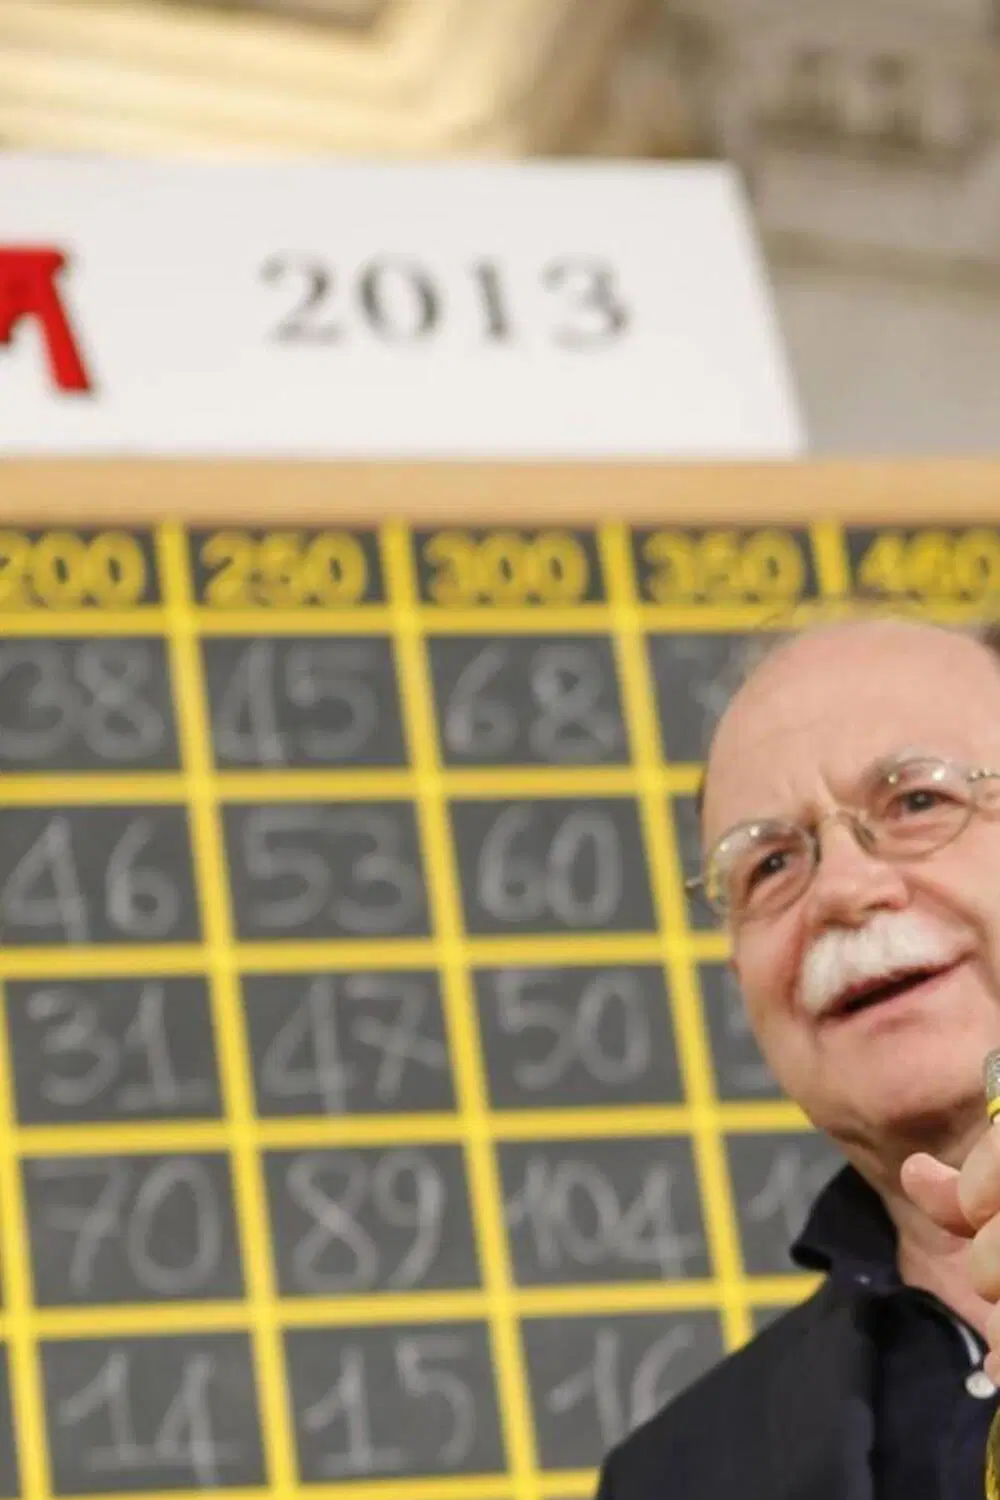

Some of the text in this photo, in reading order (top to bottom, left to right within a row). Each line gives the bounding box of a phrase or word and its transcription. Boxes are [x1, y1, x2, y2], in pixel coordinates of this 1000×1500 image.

[258, 250, 632, 350] 2013
[0, 529, 144, 608] 200
[203, 529, 368, 608] 250
[423, 529, 589, 606] 300
[643, 529, 804, 605] 350
[0, 640, 165, 761] 38
[214, 638, 380, 768] 45
[445, 642, 622, 764] 68
[2, 803, 623, 946] 46 53 60
[27, 984, 216, 1112] 31
[261, 970, 448, 1118] 47
[495, 966, 651, 1090] 50
[33, 1155, 223, 1294] 70
[286, 1150, 445, 1292] 89
[508, 1150, 702, 1283] 104
[59, 1346, 241, 1489] 14
[302, 1338, 476, 1473] 15
